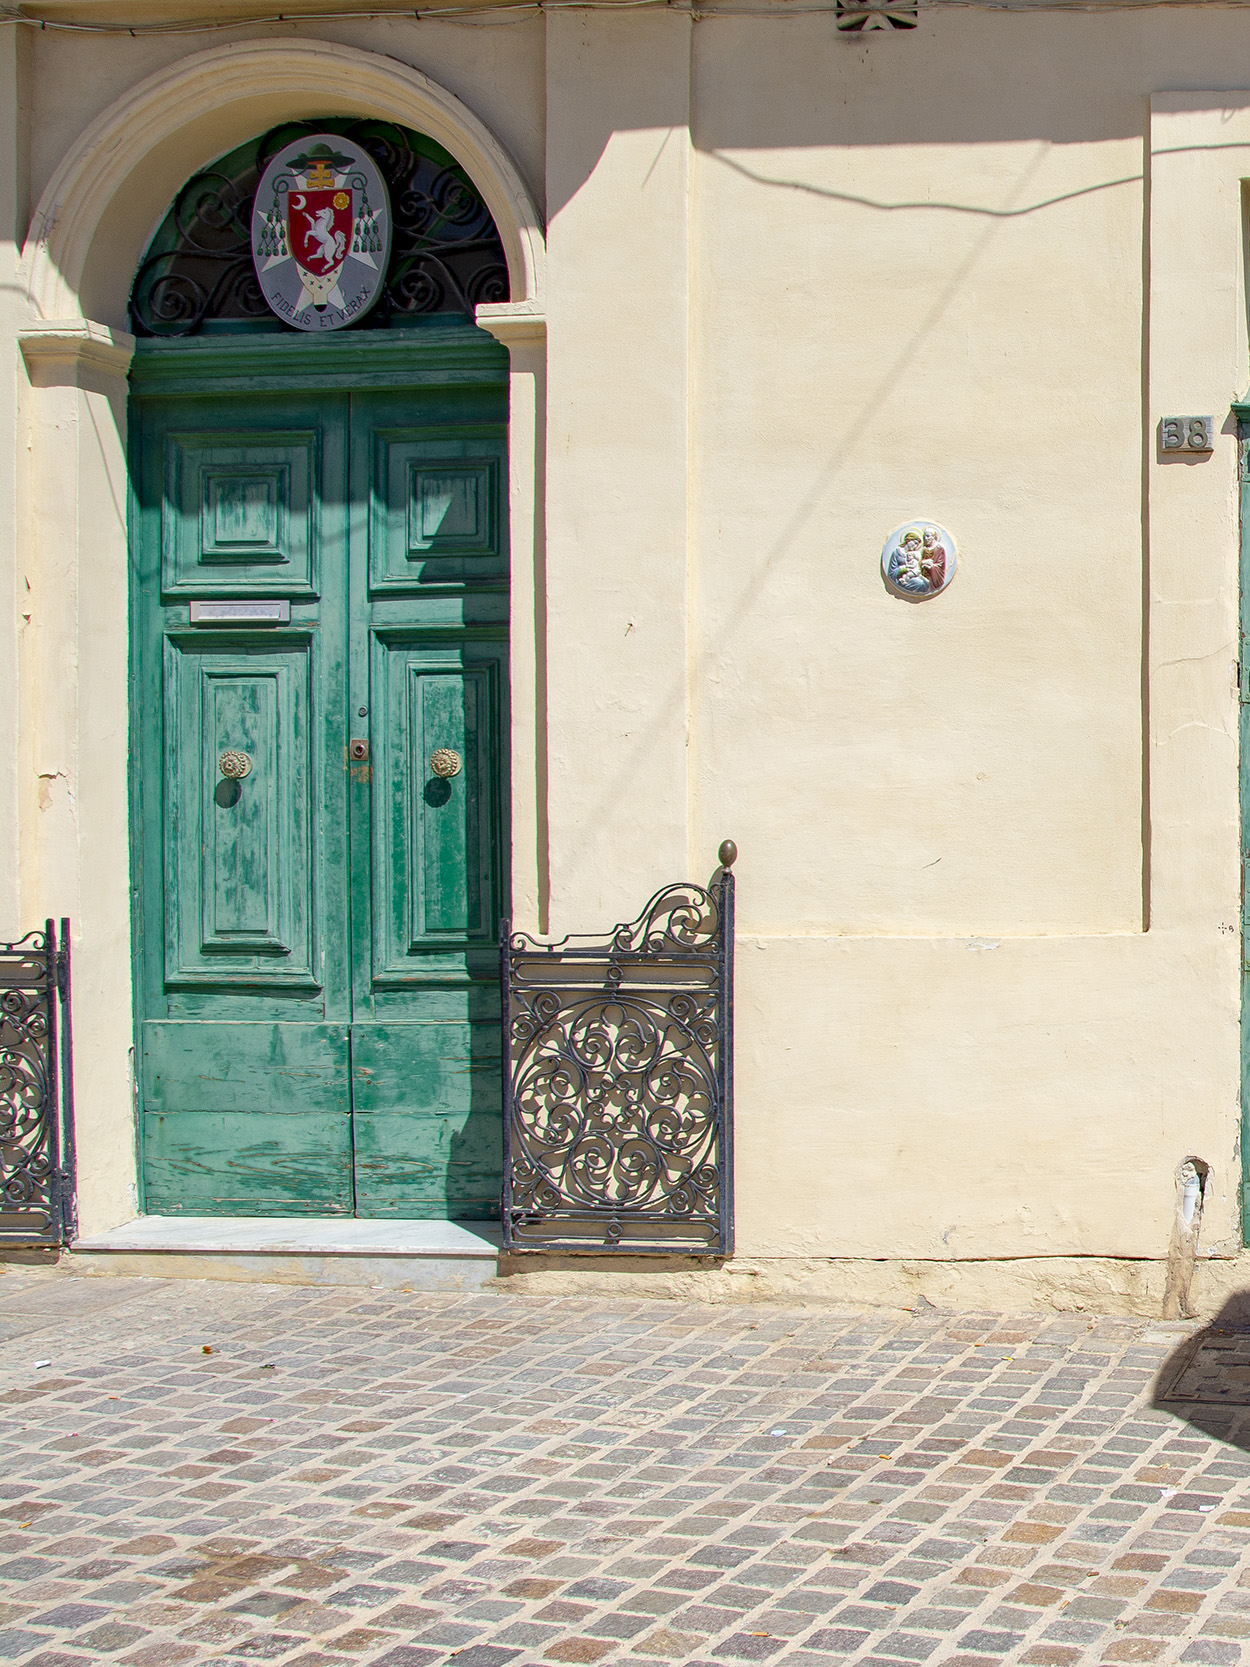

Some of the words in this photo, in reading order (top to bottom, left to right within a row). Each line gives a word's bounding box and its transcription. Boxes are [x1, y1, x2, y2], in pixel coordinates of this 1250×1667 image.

[271, 292, 312, 325] FIDELIS
[319, 313, 335, 328] ET
[336, 286, 370, 321] VERAX
[1164, 417, 1209, 449] 38
